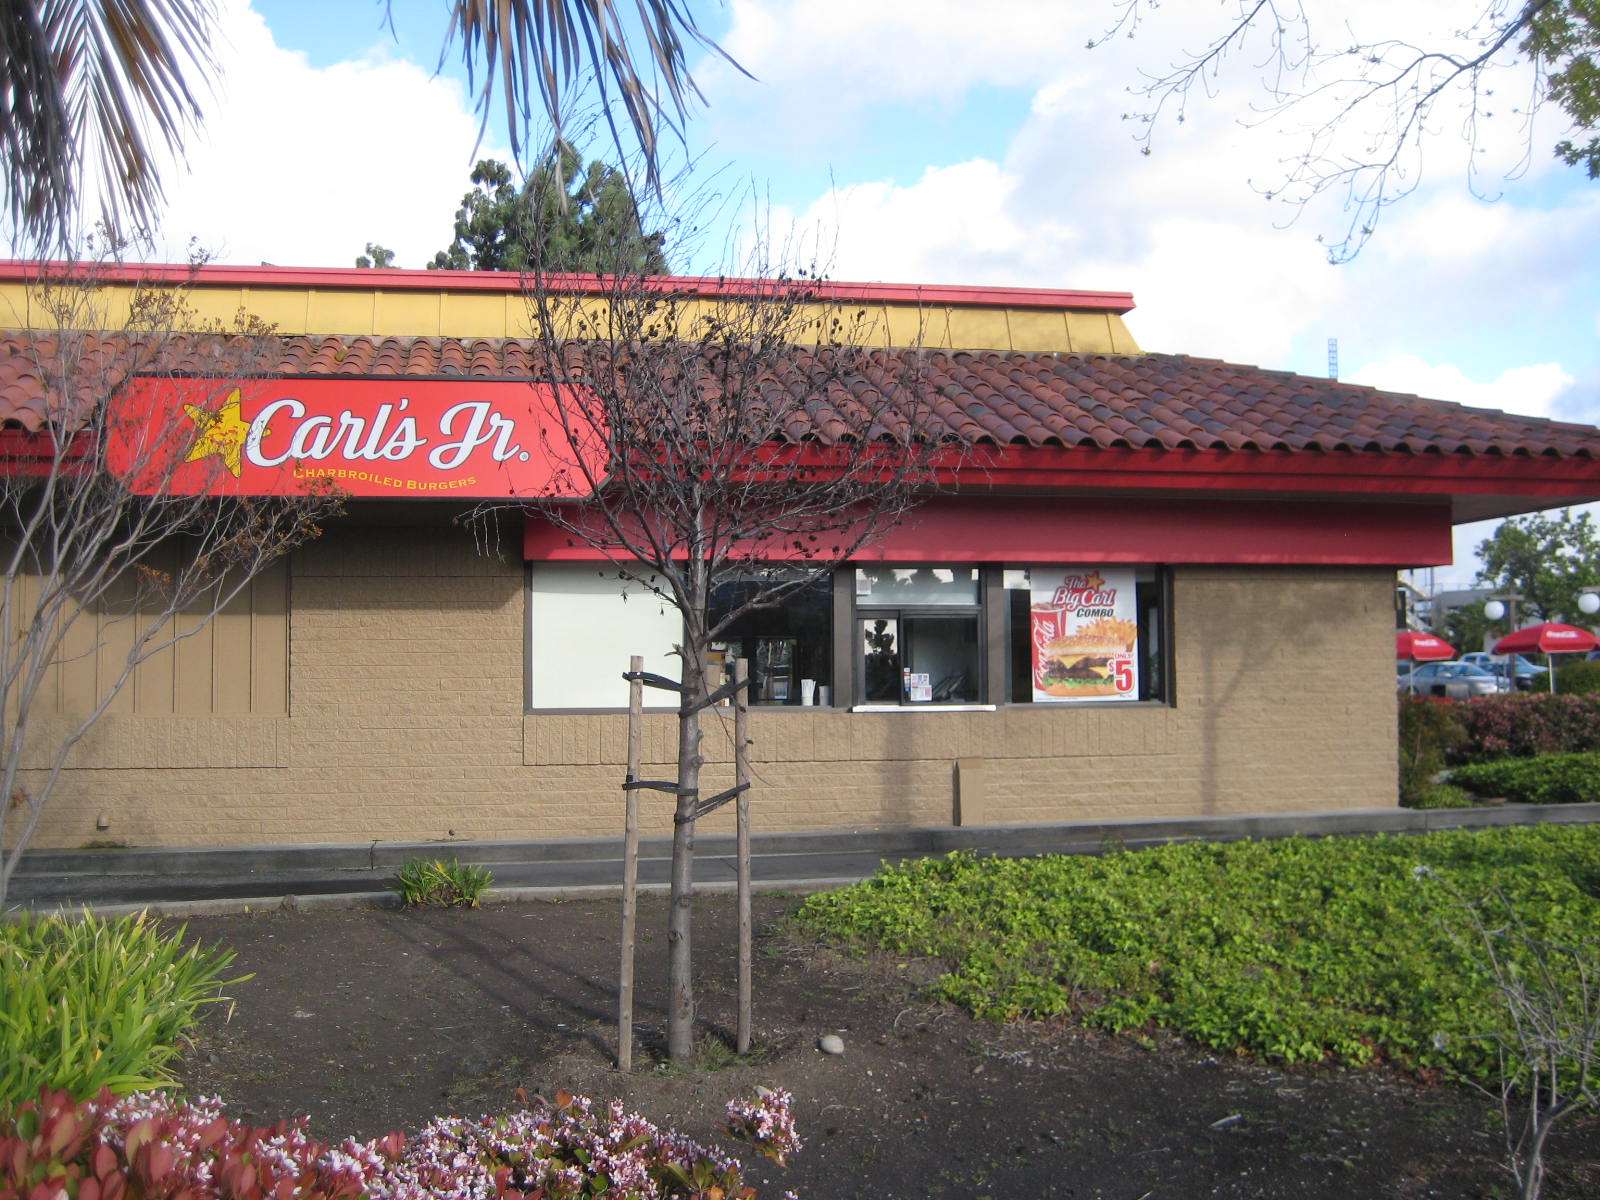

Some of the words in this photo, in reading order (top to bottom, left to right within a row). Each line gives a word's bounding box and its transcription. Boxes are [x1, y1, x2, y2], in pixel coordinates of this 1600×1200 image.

[246, 398, 428, 467] Carl's
[428, 401, 530, 470] Jr.
[293, 467, 403, 488] CHARBROILED
[406, 476, 477, 491] BURGERS
[1065, 576, 1087, 589] The
[1053, 588, 1080, 611] Big
[1081, 588, 1117, 607] Carl
[1076, 607, 1114, 618] COMBO
